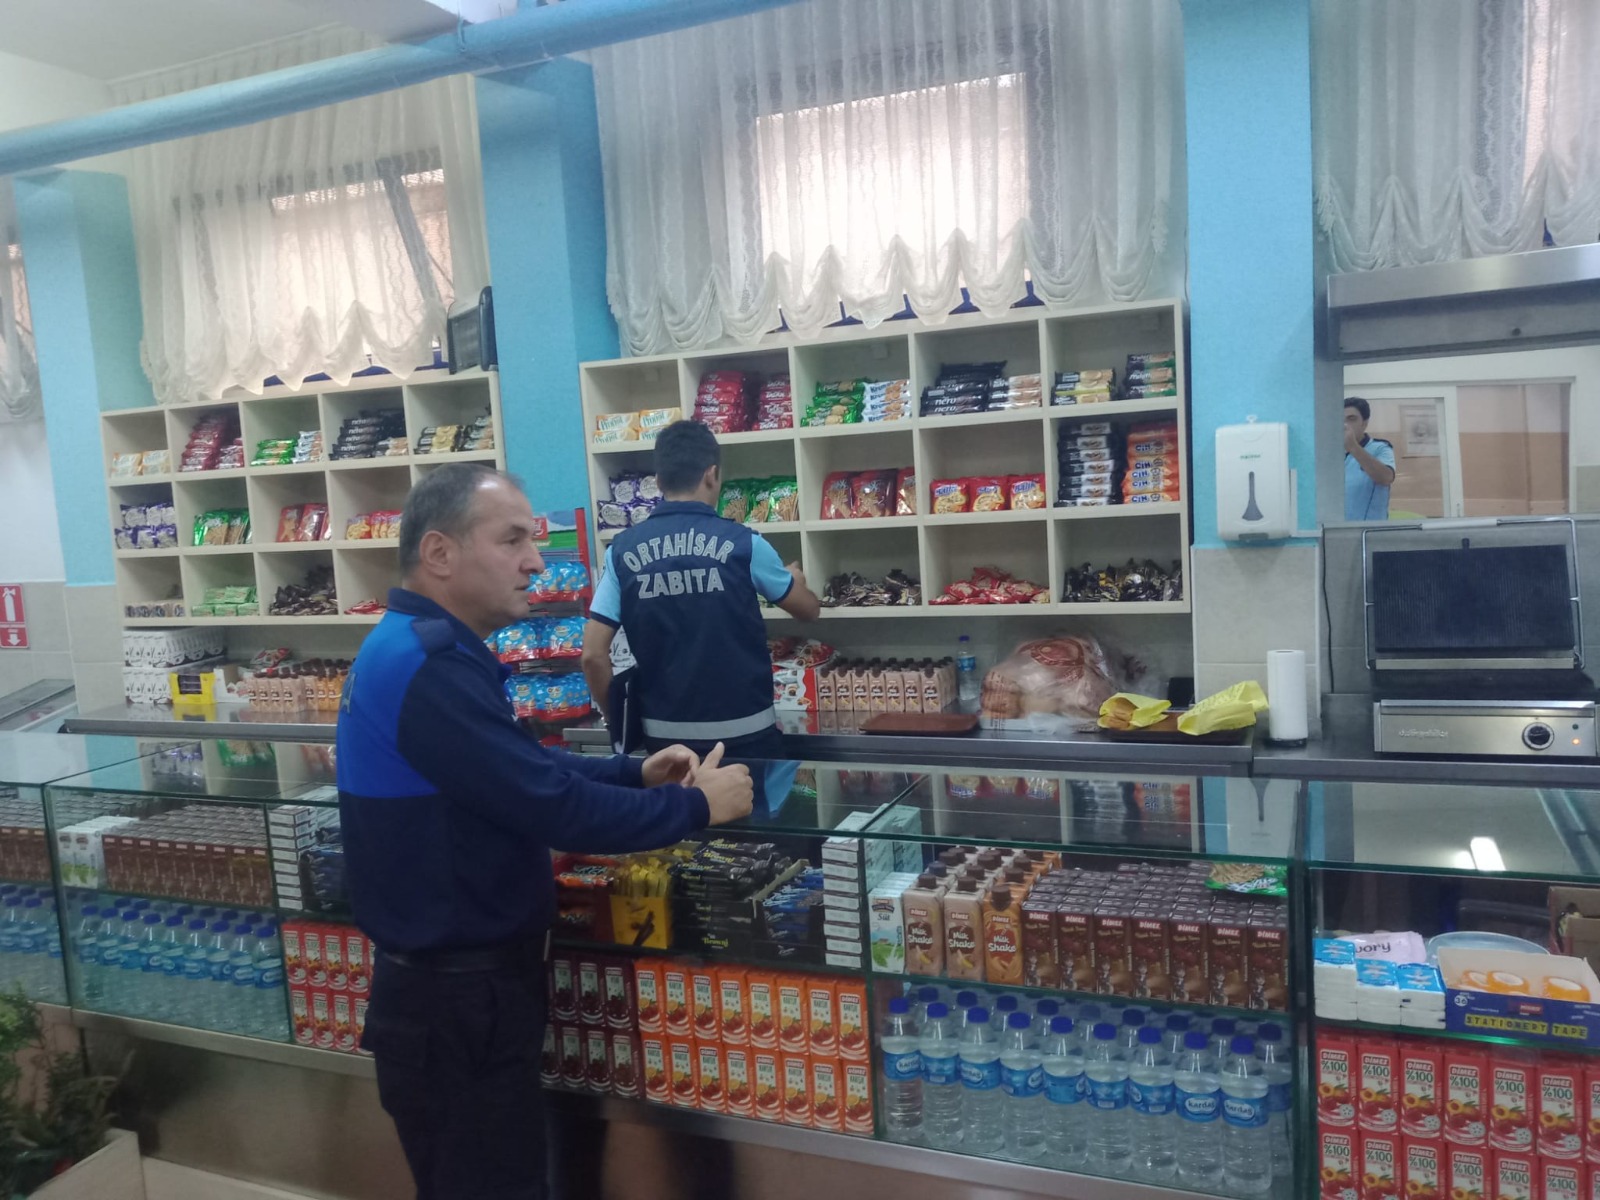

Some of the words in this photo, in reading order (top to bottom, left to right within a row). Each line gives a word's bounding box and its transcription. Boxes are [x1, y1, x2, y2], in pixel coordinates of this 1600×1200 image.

[623, 528, 735, 572] ORTAHİSAR
[636, 568, 725, 599] ZABITA
[878, 912, 890, 920] Süt
[912, 928, 927, 936] Milk
[907, 935, 933, 944] Shake
[948, 939, 976, 948] Shake
[994, 936, 1010, 944] Milk
[988, 942, 1016, 952] Shake
[1466, 1016, 1547, 1032] STATIONERY
[1554, 1026, 1586, 1037] TAPE
[1322, 1052, 1346, 1060] DİMES
[1364, 1056, 1388, 1066] DİMES
[1321, 1060, 1348, 1072] %100
[1363, 1065, 1390, 1077] %100
[1407, 1062, 1431, 1071] DİMES
[1406, 1070, 1434, 1083] %100
[1451, 1067, 1476, 1076] DİMES
[1496, 1071, 1523, 1080] DİMES
[1450, 1076, 1478, 1088] %100
[1544, 1078, 1571, 1087] DİMES
[1495, 1081, 1524, 1094] %100
[1542, 1087, 1573, 1100] %100
[1325, 1136, 1348, 1145] DİMES
[1324, 1144, 1350, 1156] %100
[1366, 1142, 1391, 1150] DİMES
[1366, 1150, 1392, 1162] %100
[1410, 1148, 1434, 1157] DİMES
[1408, 1156, 1436, 1170] %100
[1454, 1154, 1480, 1164] DİMES
[1454, 1163, 1482, 1176] %100
[1501, 1161, 1528, 1171] DİMES
[1500, 1170, 1529, 1184] %100
[1548, 1168, 1576, 1178] DİMES
[1547, 1177, 1576, 1190] %100
